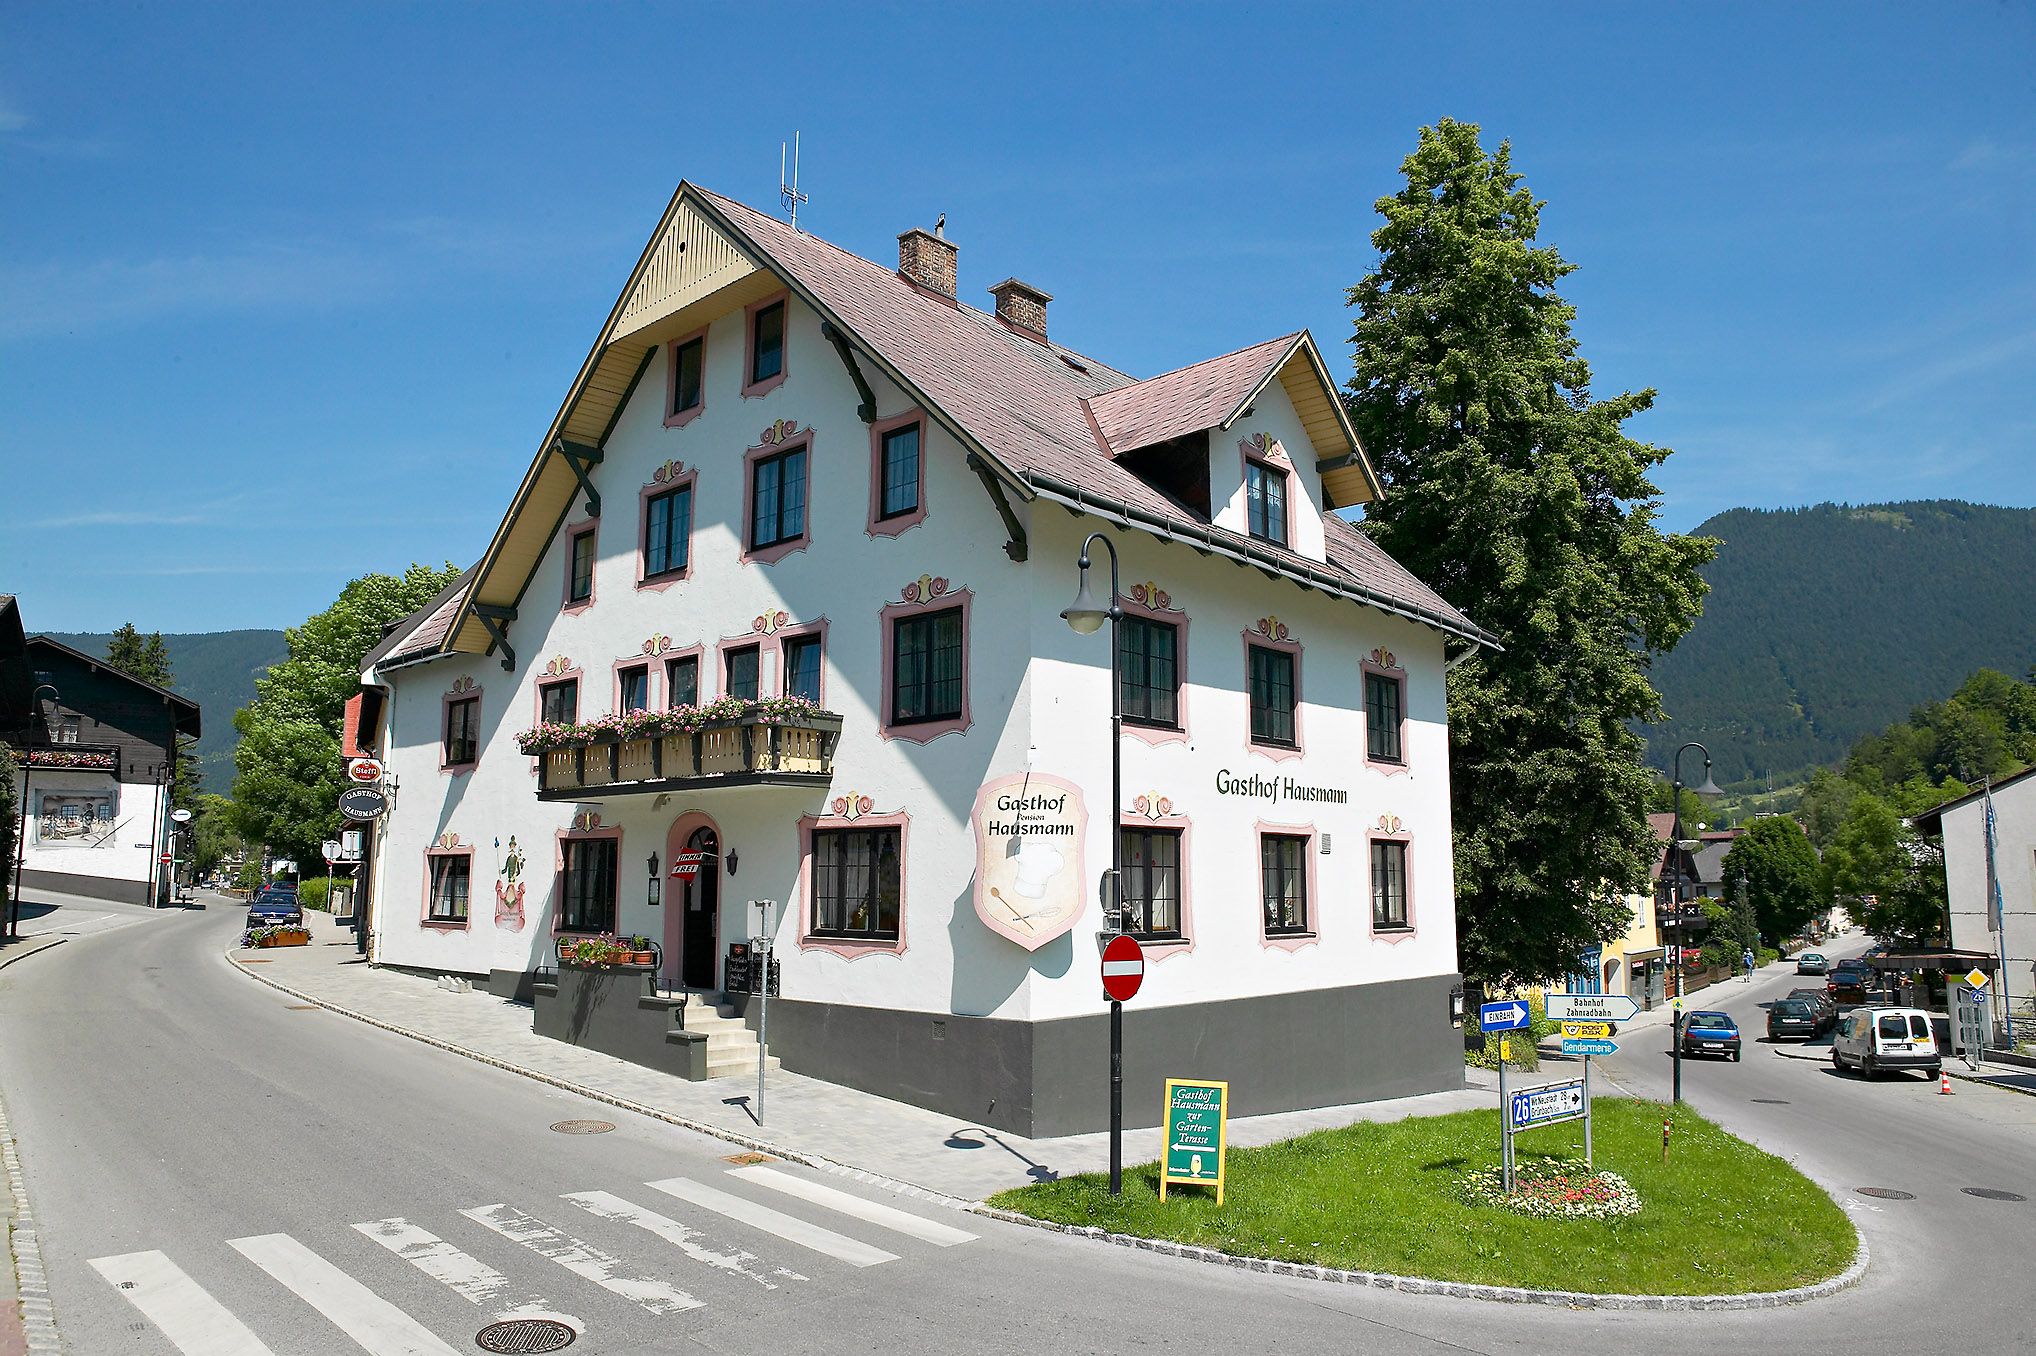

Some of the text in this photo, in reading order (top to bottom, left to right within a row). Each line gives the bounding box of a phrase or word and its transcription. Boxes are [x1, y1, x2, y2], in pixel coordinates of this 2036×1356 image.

[1216, 768, 1347, 805] Gasthof Hausmann
[346, 790, 382, 800] GASTHOF
[997, 794, 1067, 814] Gasthof
[344, 806, 383, 817] HAUSMANN
[1016, 813, 1045, 821] Pension
[988, 820, 1074, 836] Hausmann
[1574, 998, 1604, 1007] Bahnhof
[1489, 1011, 1515, 1022] EINBAHN
[1566, 1008, 1612, 1017] Zahnradbahn
[1564, 1042, 1612, 1054] Gendarmerie
[1176, 1088, 1215, 1103] Gasthof
[1171, 1098, 1221, 1111] Hausmann
[1515, 1097, 1530, 1122] 26
[1186, 1112, 1203, 1122] zur
[1176, 1121, 1212, 1133] Garten-
[1179, 1133, 1209, 1144] Terasse
